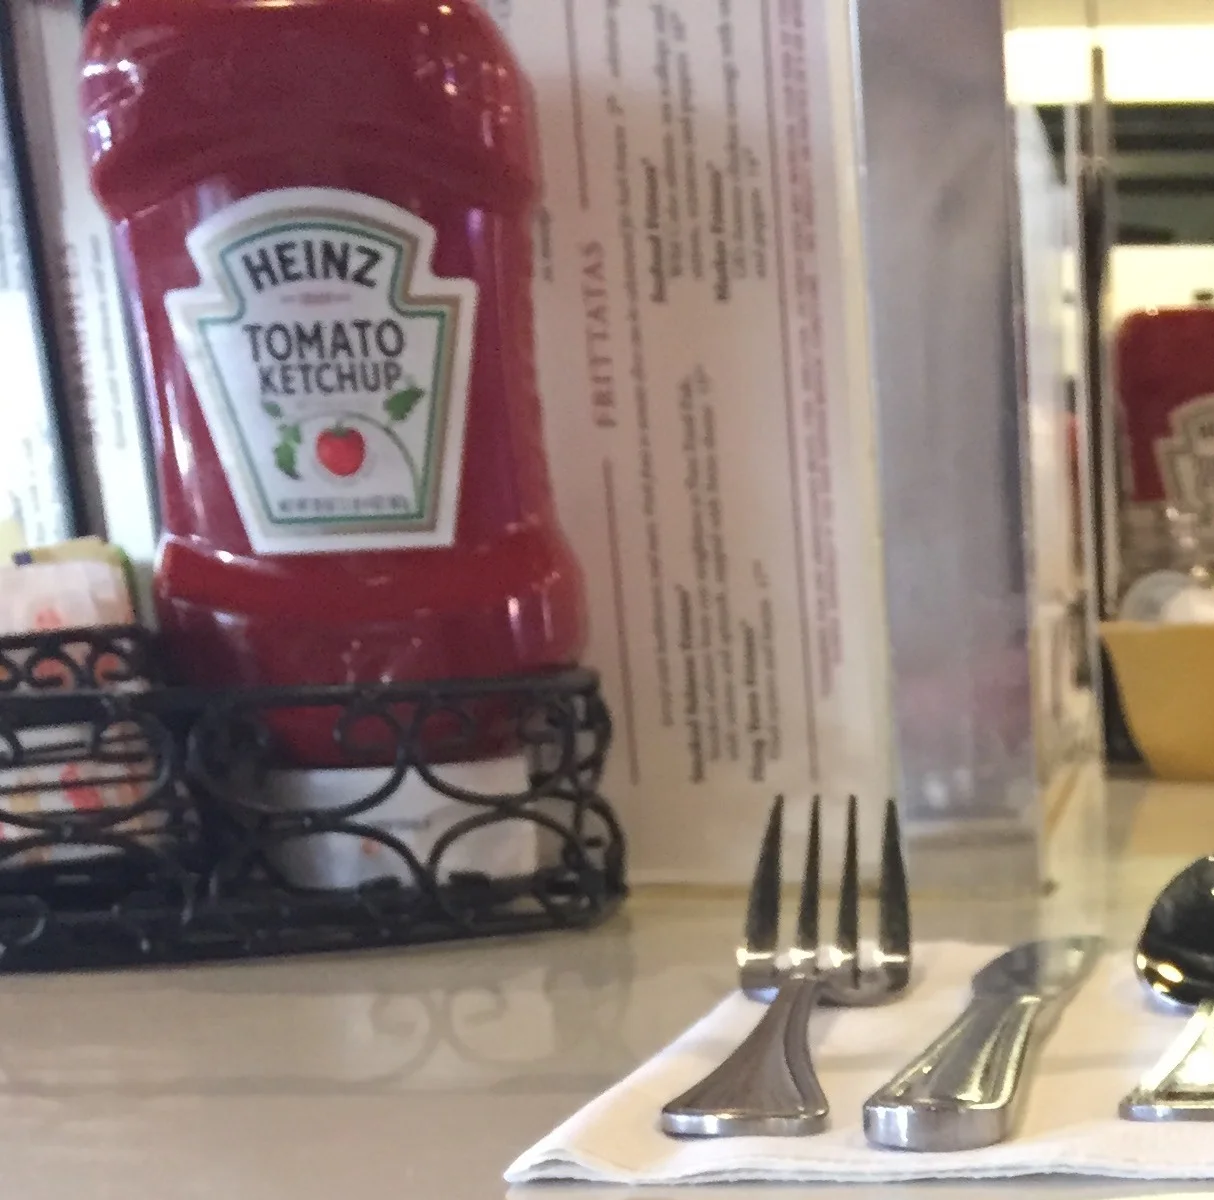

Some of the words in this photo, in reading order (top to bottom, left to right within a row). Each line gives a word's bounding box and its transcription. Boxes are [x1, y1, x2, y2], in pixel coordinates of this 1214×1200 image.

[242, 240, 383, 292] HEINZ
[242, 318, 404, 362] TOMATO
[579, 240, 618, 429] FRITTATAS
[258, 361, 401, 395] KETCHUP
